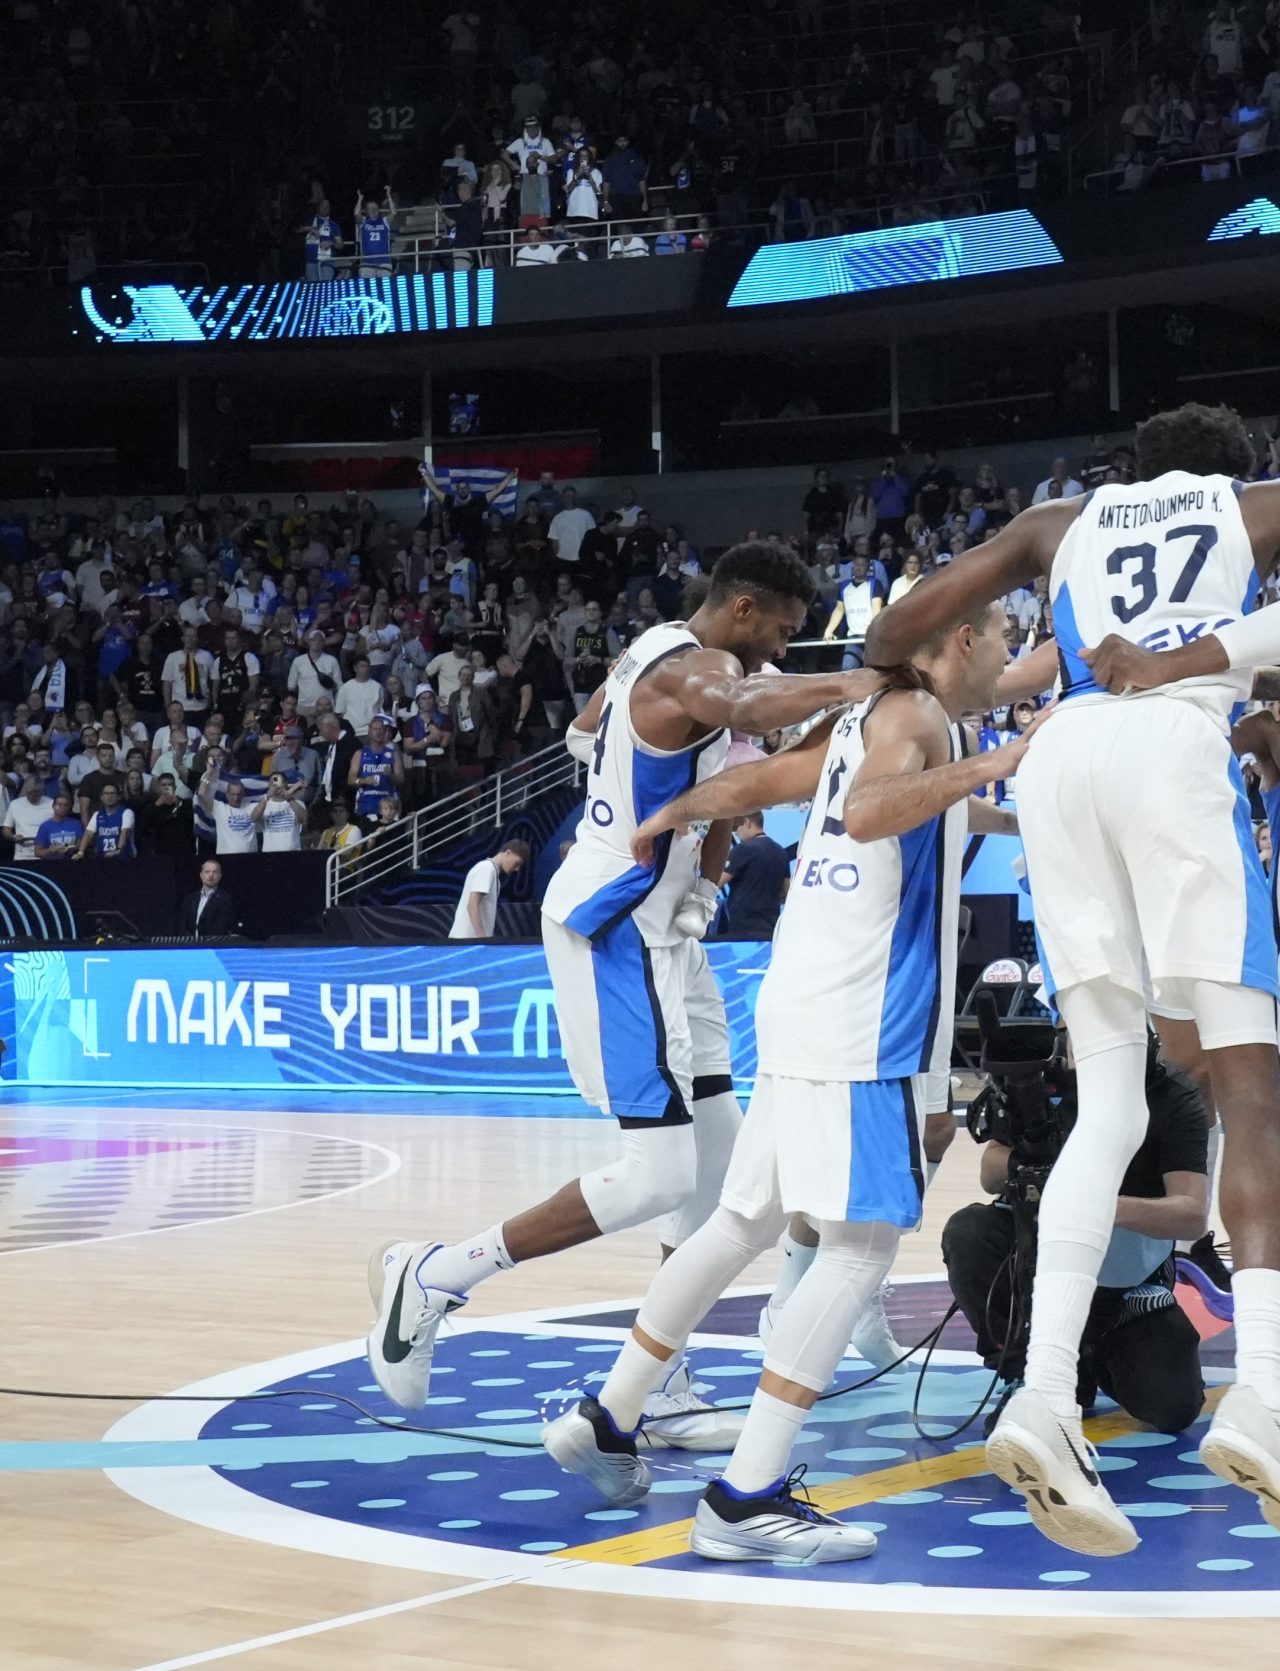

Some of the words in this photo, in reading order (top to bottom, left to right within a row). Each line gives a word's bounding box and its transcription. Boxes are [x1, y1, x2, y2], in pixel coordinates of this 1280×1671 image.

[368, 107, 415, 129] 312
[370, 232, 381, 241] 23
[1106, 524, 1218, 624] 37
[103, 839, 116, 851] 23
[127, 979, 290, 1049] MAKE
[320, 984, 480, 1056] YOUR
